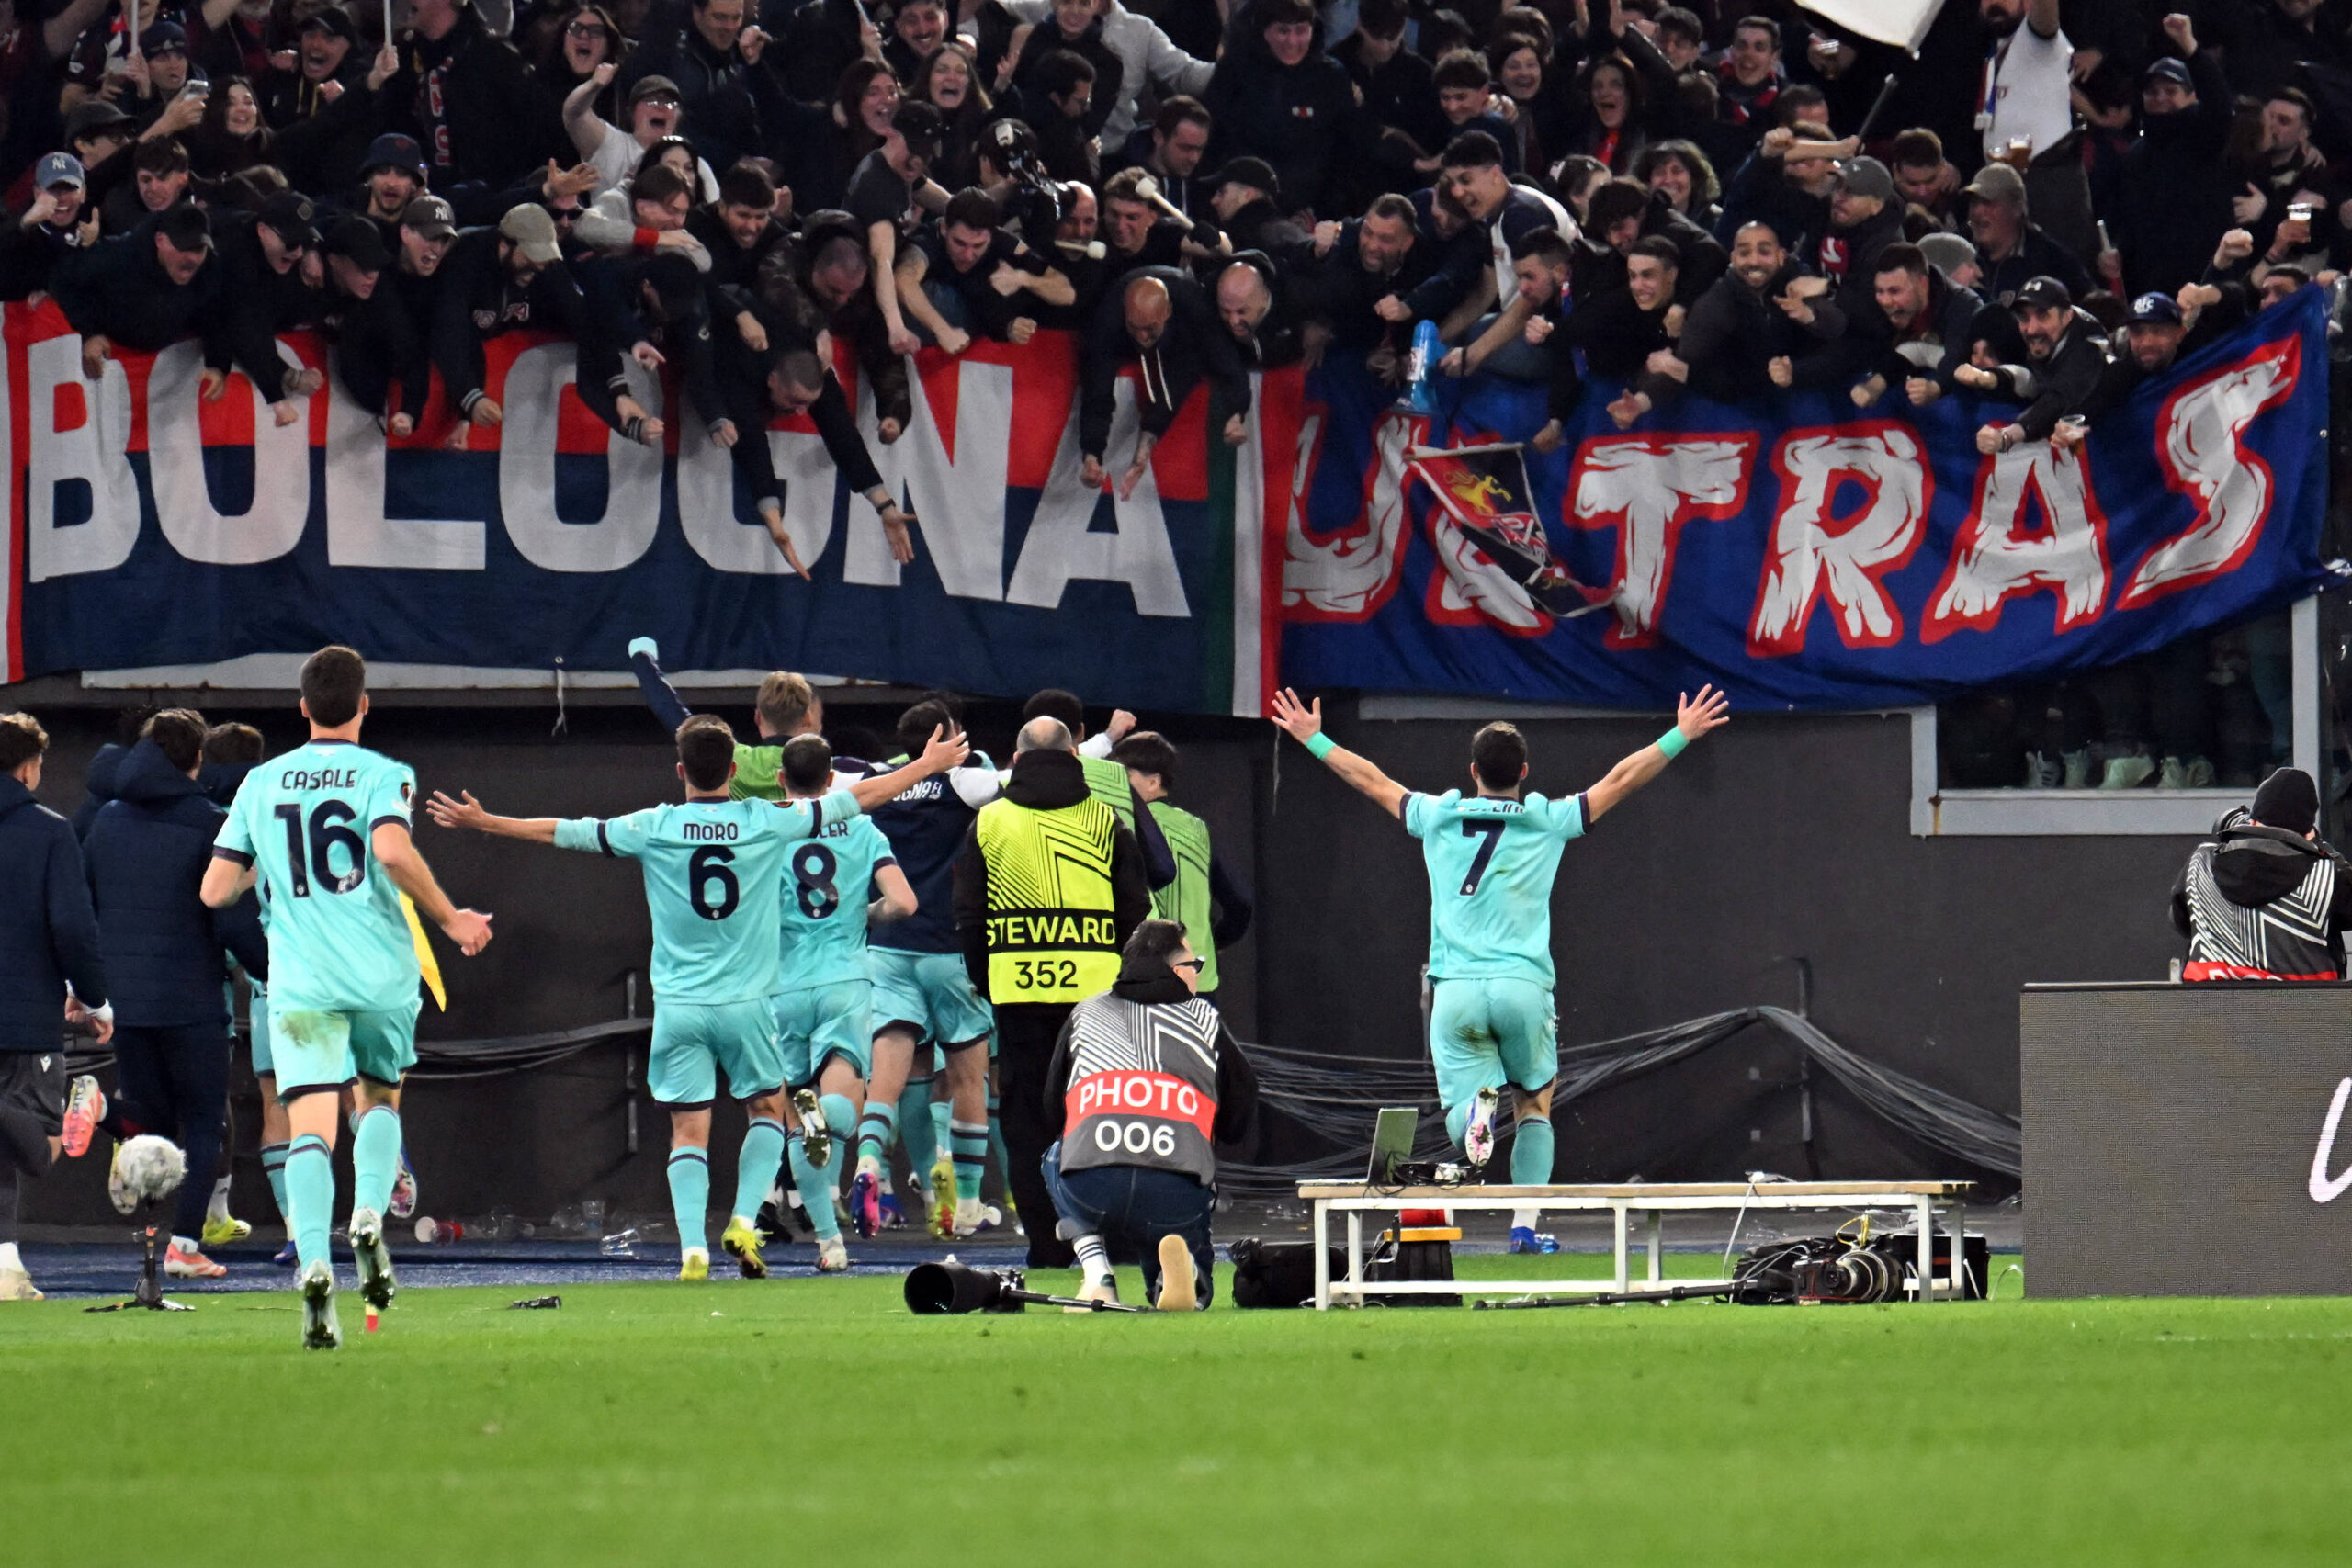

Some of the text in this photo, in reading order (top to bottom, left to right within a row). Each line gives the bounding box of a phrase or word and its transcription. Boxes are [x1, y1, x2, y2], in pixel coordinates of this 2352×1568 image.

[28, 333, 1192, 617] BOLOGNA
[280, 768, 358, 791] CASALE
[273, 799, 366, 898] 16
[683, 822, 739, 840] MORO
[1459, 818, 1506, 896] 7
[689, 844, 740, 921] 6
[792, 842, 839, 919] 8
[986, 916, 1116, 947] STEWARD
[1014, 960, 1079, 990] 352
[1079, 1076, 1198, 1116] PHOTO
[1094, 1120, 1175, 1156] 006
